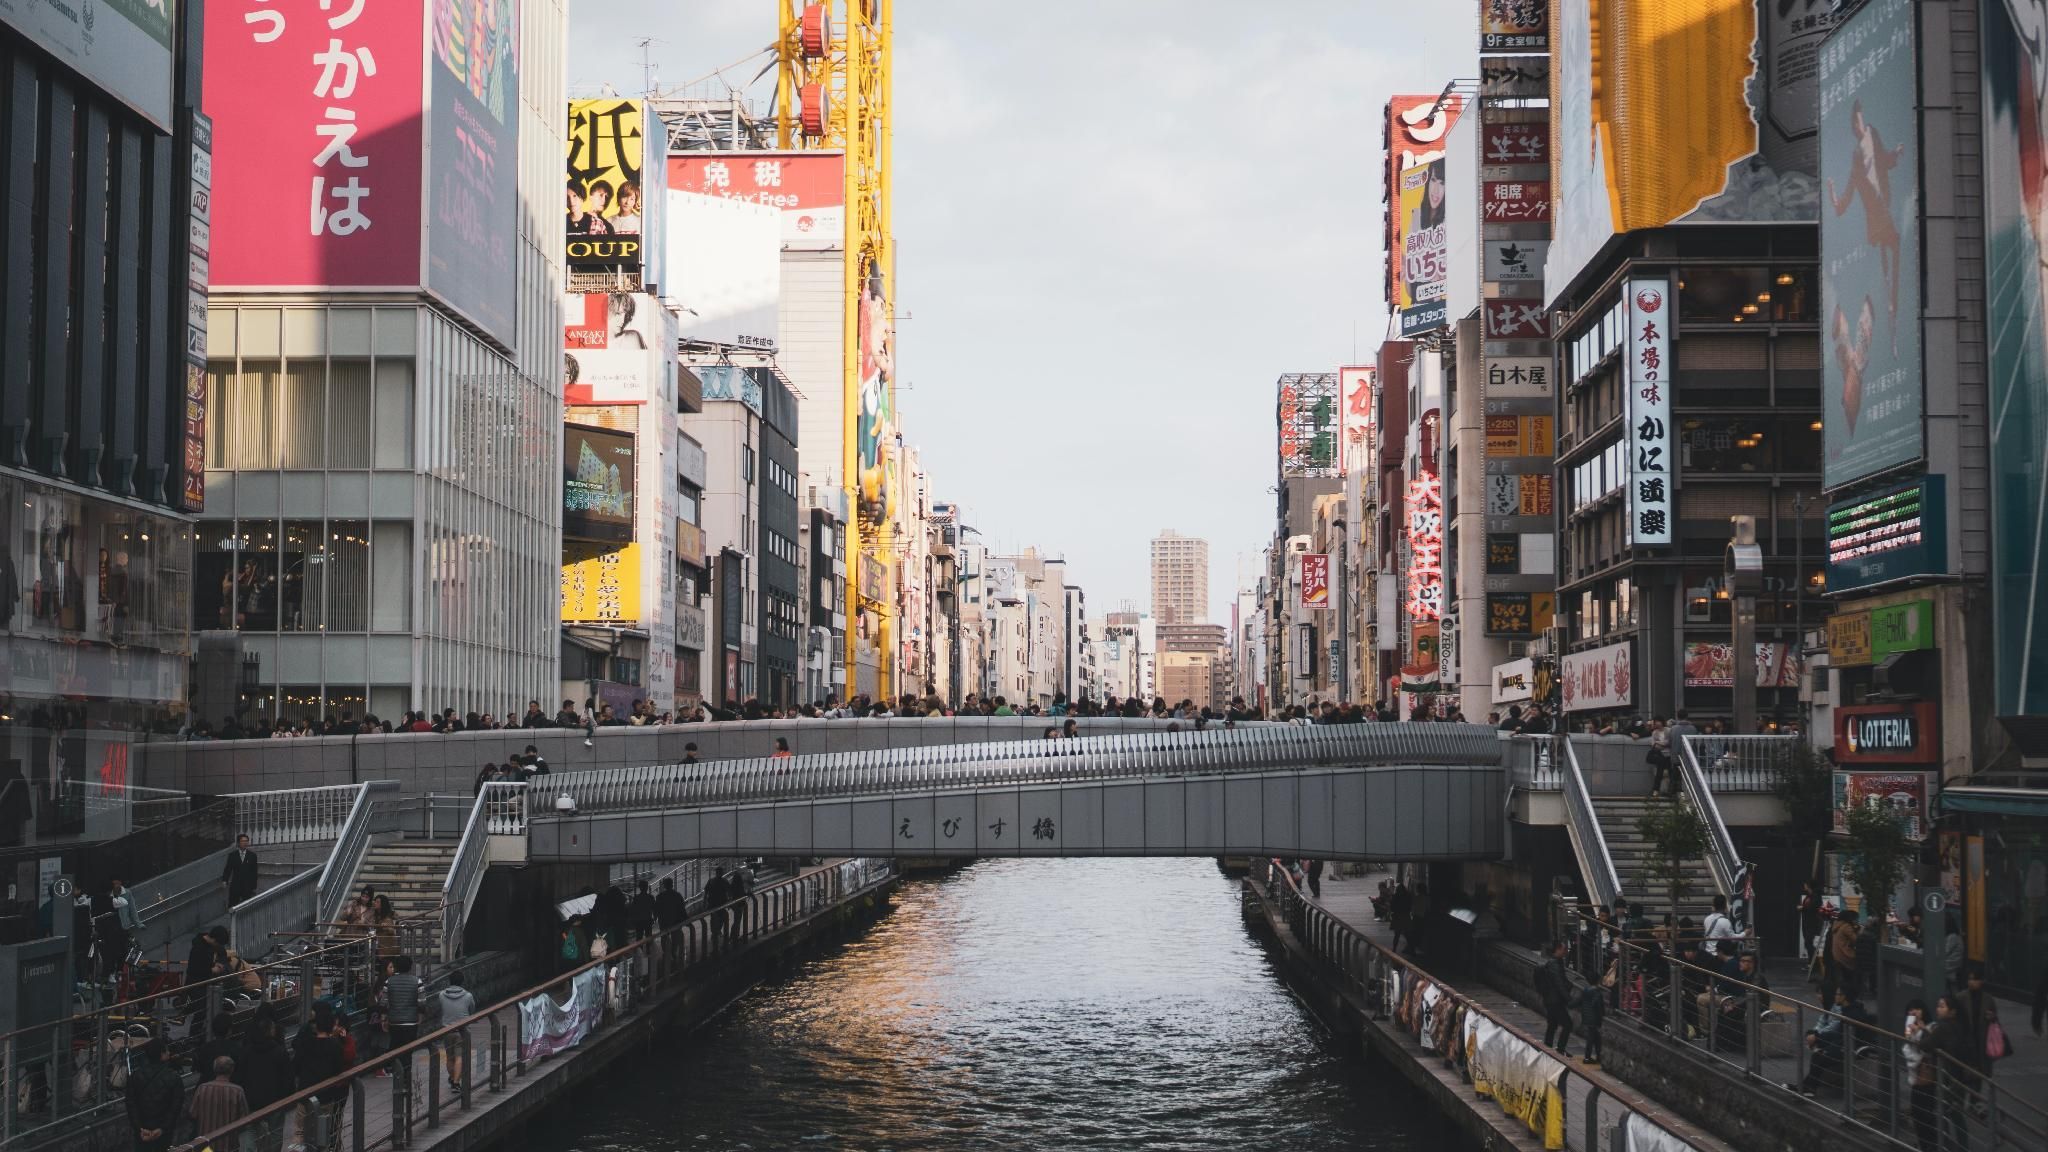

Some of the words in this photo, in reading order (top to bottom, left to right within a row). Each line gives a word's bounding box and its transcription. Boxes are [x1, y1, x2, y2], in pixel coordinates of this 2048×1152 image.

[1486, 34, 1503, 47] 9F
[703, 161, 782, 187] 免税
[759, 192, 799, 207] Free
[1494, 184, 1523, 199] 相席
[1485, 201, 1549, 217] ダイニング
[1489, 363, 1547, 385] 白木屋
[1639, 320, 1661, 406] 本場の味
[196, 369, 205, 494] インターネット
[186, 420, 195, 491] コミック
[1304, 562, 1314, 595] ドラッグ
[1313, 557, 1326, 588] ツルハ
[1492, 602, 1526, 616] びっくり
[1490, 617, 1529, 631] ドンキー
[1859, 719, 1912, 748] LOTTERIA
[898, 817, 1056, 841] えびす橋
